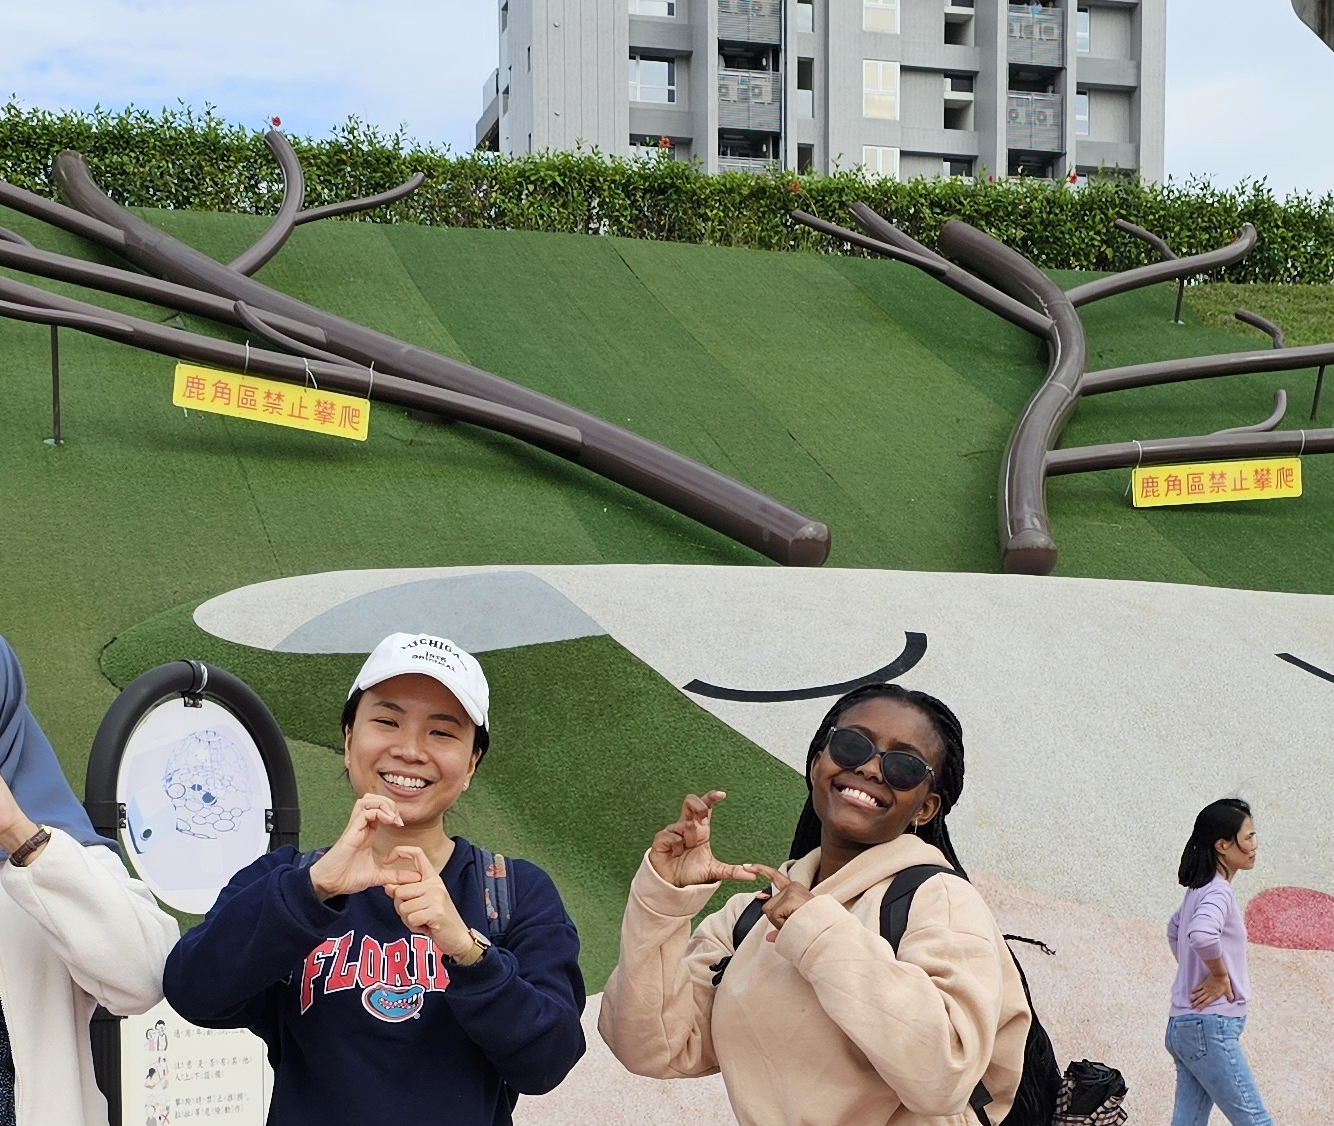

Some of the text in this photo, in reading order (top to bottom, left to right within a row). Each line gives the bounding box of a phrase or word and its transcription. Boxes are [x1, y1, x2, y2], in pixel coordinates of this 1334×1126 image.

[182, 375, 360, 431] 鹿角區禁止攀爬
[1140, 466, 1294, 499] 鹿角區禁止攀爬
